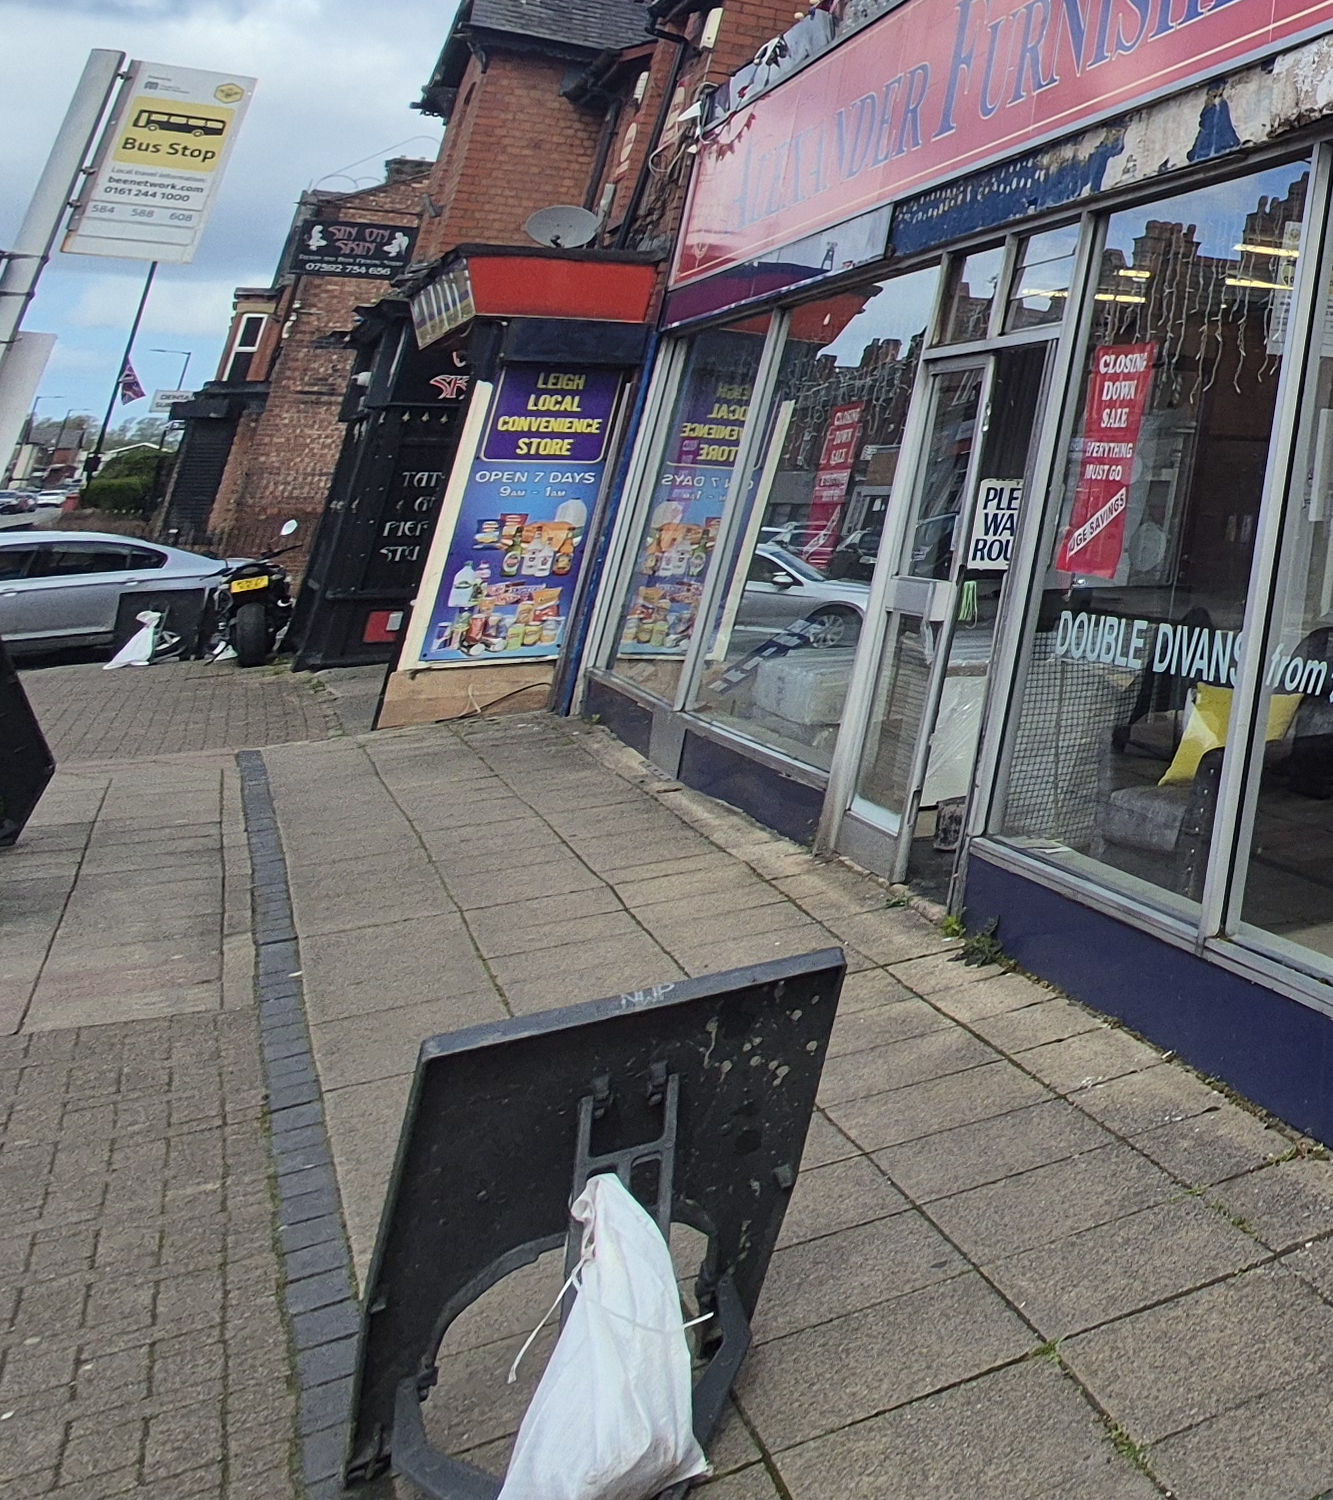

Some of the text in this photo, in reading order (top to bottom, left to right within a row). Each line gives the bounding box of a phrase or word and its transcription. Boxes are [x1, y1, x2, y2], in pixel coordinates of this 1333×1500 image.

[122, 137, 216, 162] Bus Stop
[108, 176, 204, 193] beenetwork.com
[104, 186, 190, 202] 0161 244 1000
[169, 212, 193, 222] 608
[335, 240, 376, 256] SKIN
[1099, 353, 1148, 374] CLOSING
[537, 372, 586, 390] LEIGH
[1101, 380, 1137, 401] DOWN
[527, 394, 582, 412] LOCAL
[497, 416, 602, 433] CONVENIENCE
[1100, 408, 1129, 428] SALE
[516, 438, 574, 455] STORE
[475, 471, 596, 484] OPEN 7 DAYS
[1084, 464, 1123, 481] MUST GO
[983, 486, 1022, 511] PLE
[1089, 493, 1124, 536] SAVINGS
[1055, 610, 1149, 670] DOUBLE
[1265, 642, 1328, 696] from
